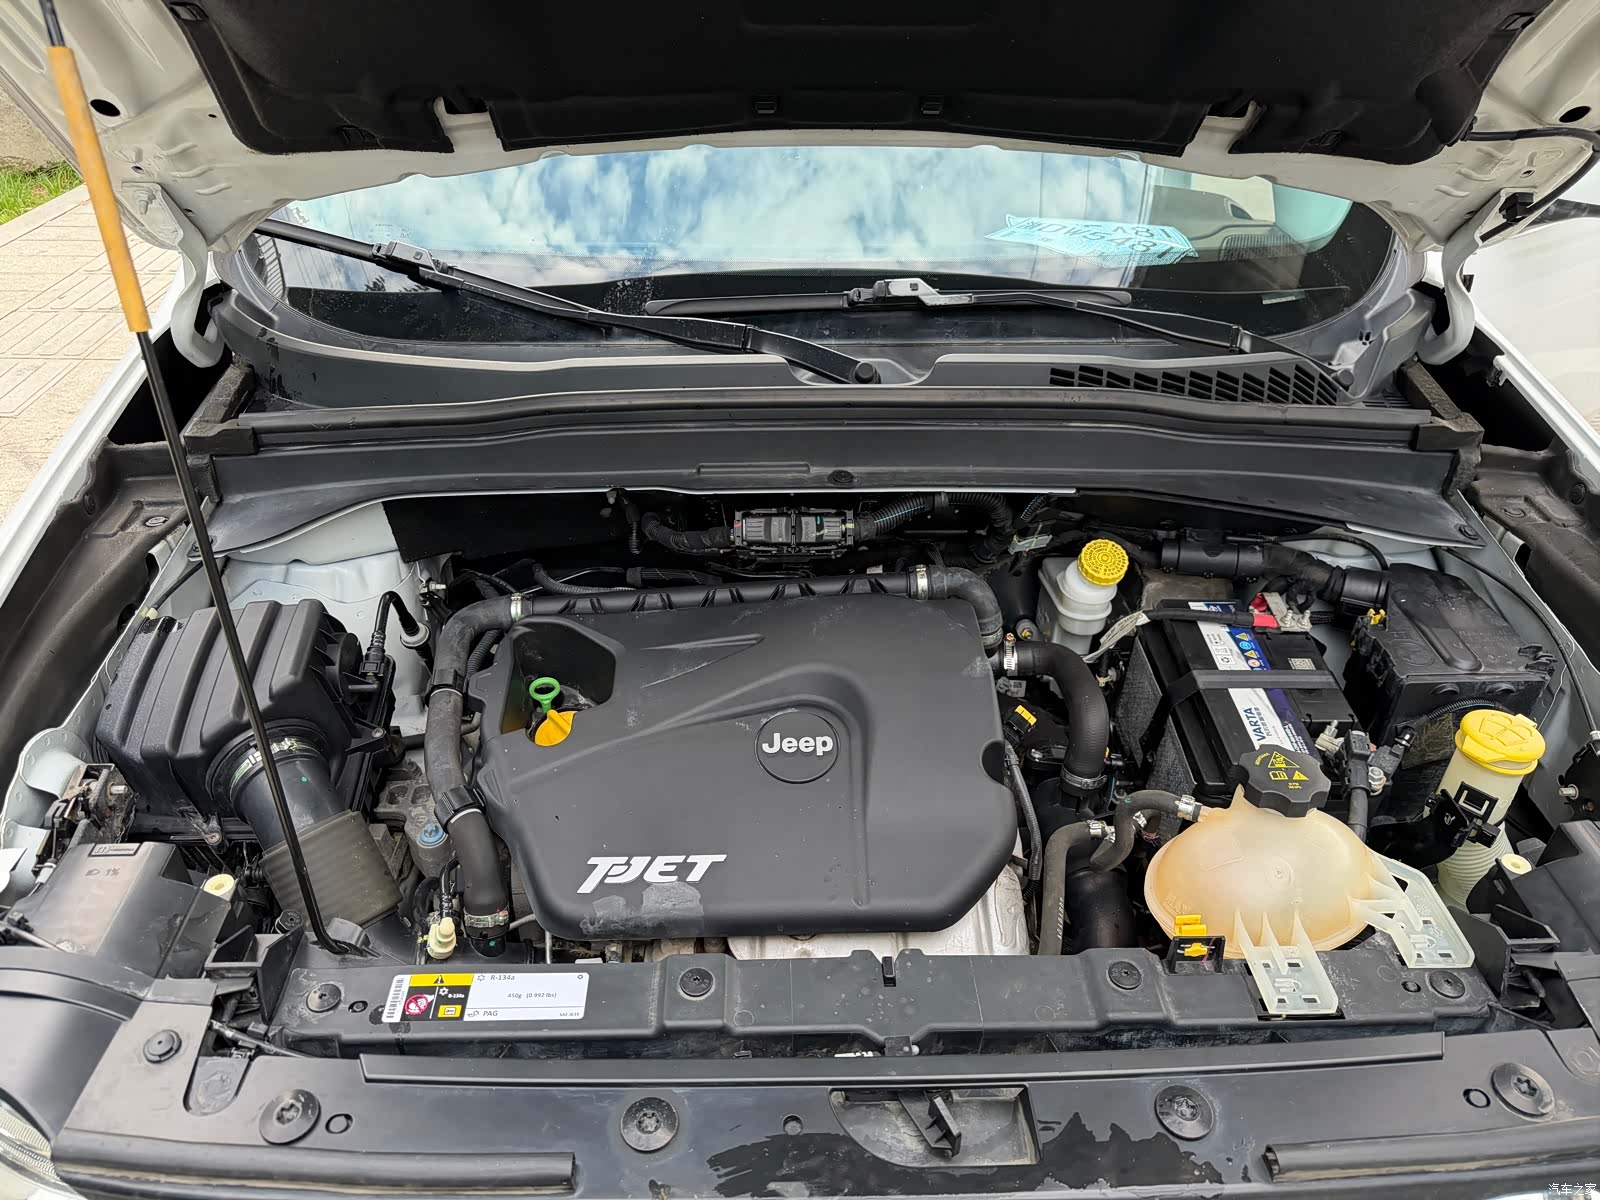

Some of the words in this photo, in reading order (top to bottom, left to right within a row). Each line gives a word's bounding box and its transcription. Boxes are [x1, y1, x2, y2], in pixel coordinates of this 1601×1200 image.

[1243, 707, 1267, 742] VARTA
[761, 732, 834, 756] Jeep
[482, 1010, 499, 1018] PAG
